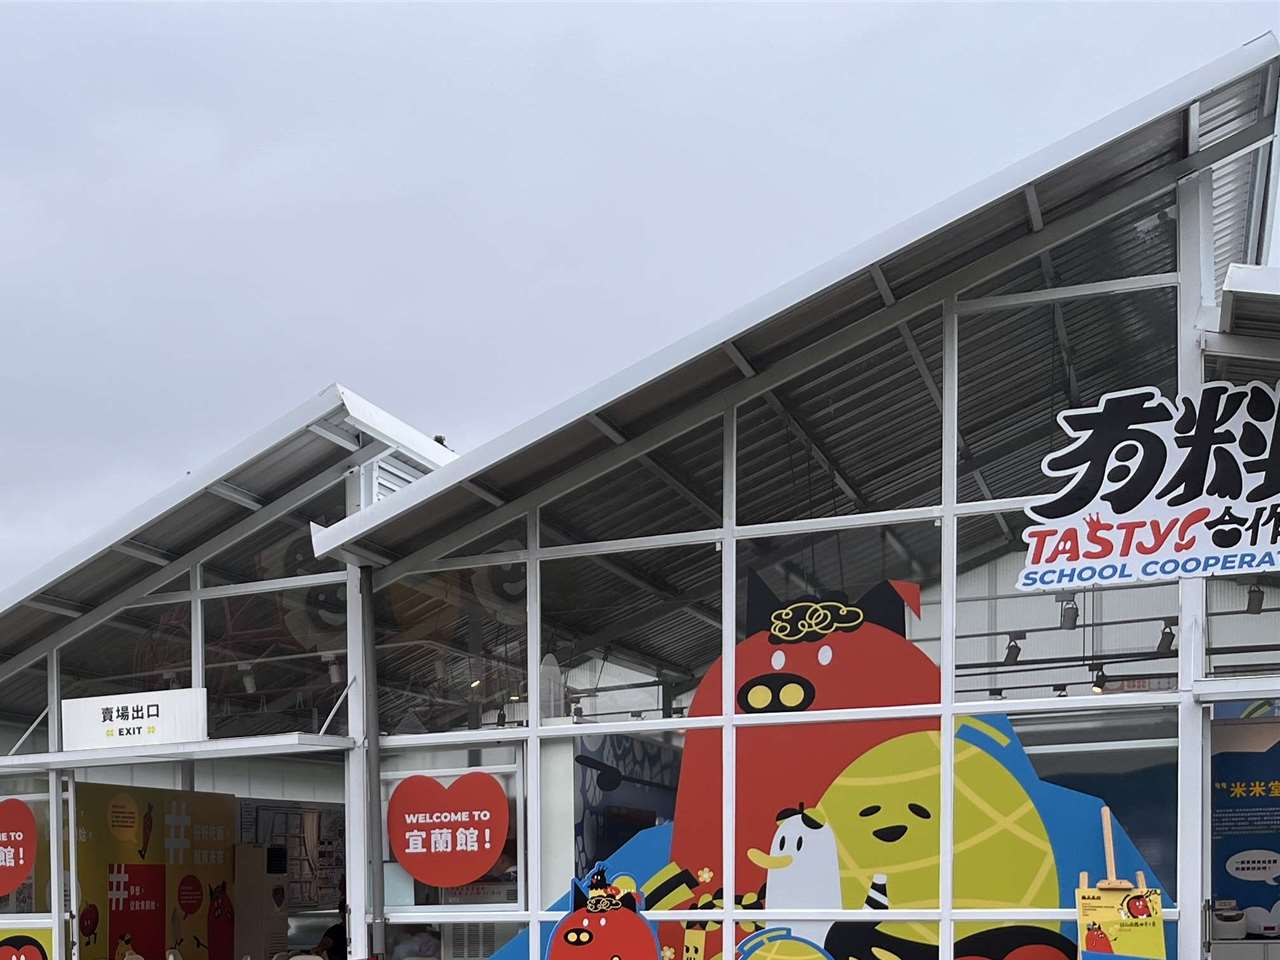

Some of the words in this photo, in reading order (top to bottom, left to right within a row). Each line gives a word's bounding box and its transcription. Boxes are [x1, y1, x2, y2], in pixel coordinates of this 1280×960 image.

[1022, 563, 1132, 587] SCHOOL
[1141, 551, 1280, 576] COOPERA
[101, 704, 160, 723] 賣場出口
[118, 726, 143, 736] EXIT
[404, 811, 470, 824] WELCOME
[472, 810, 491, 821] TO
[9, 831, 24, 841] TO
